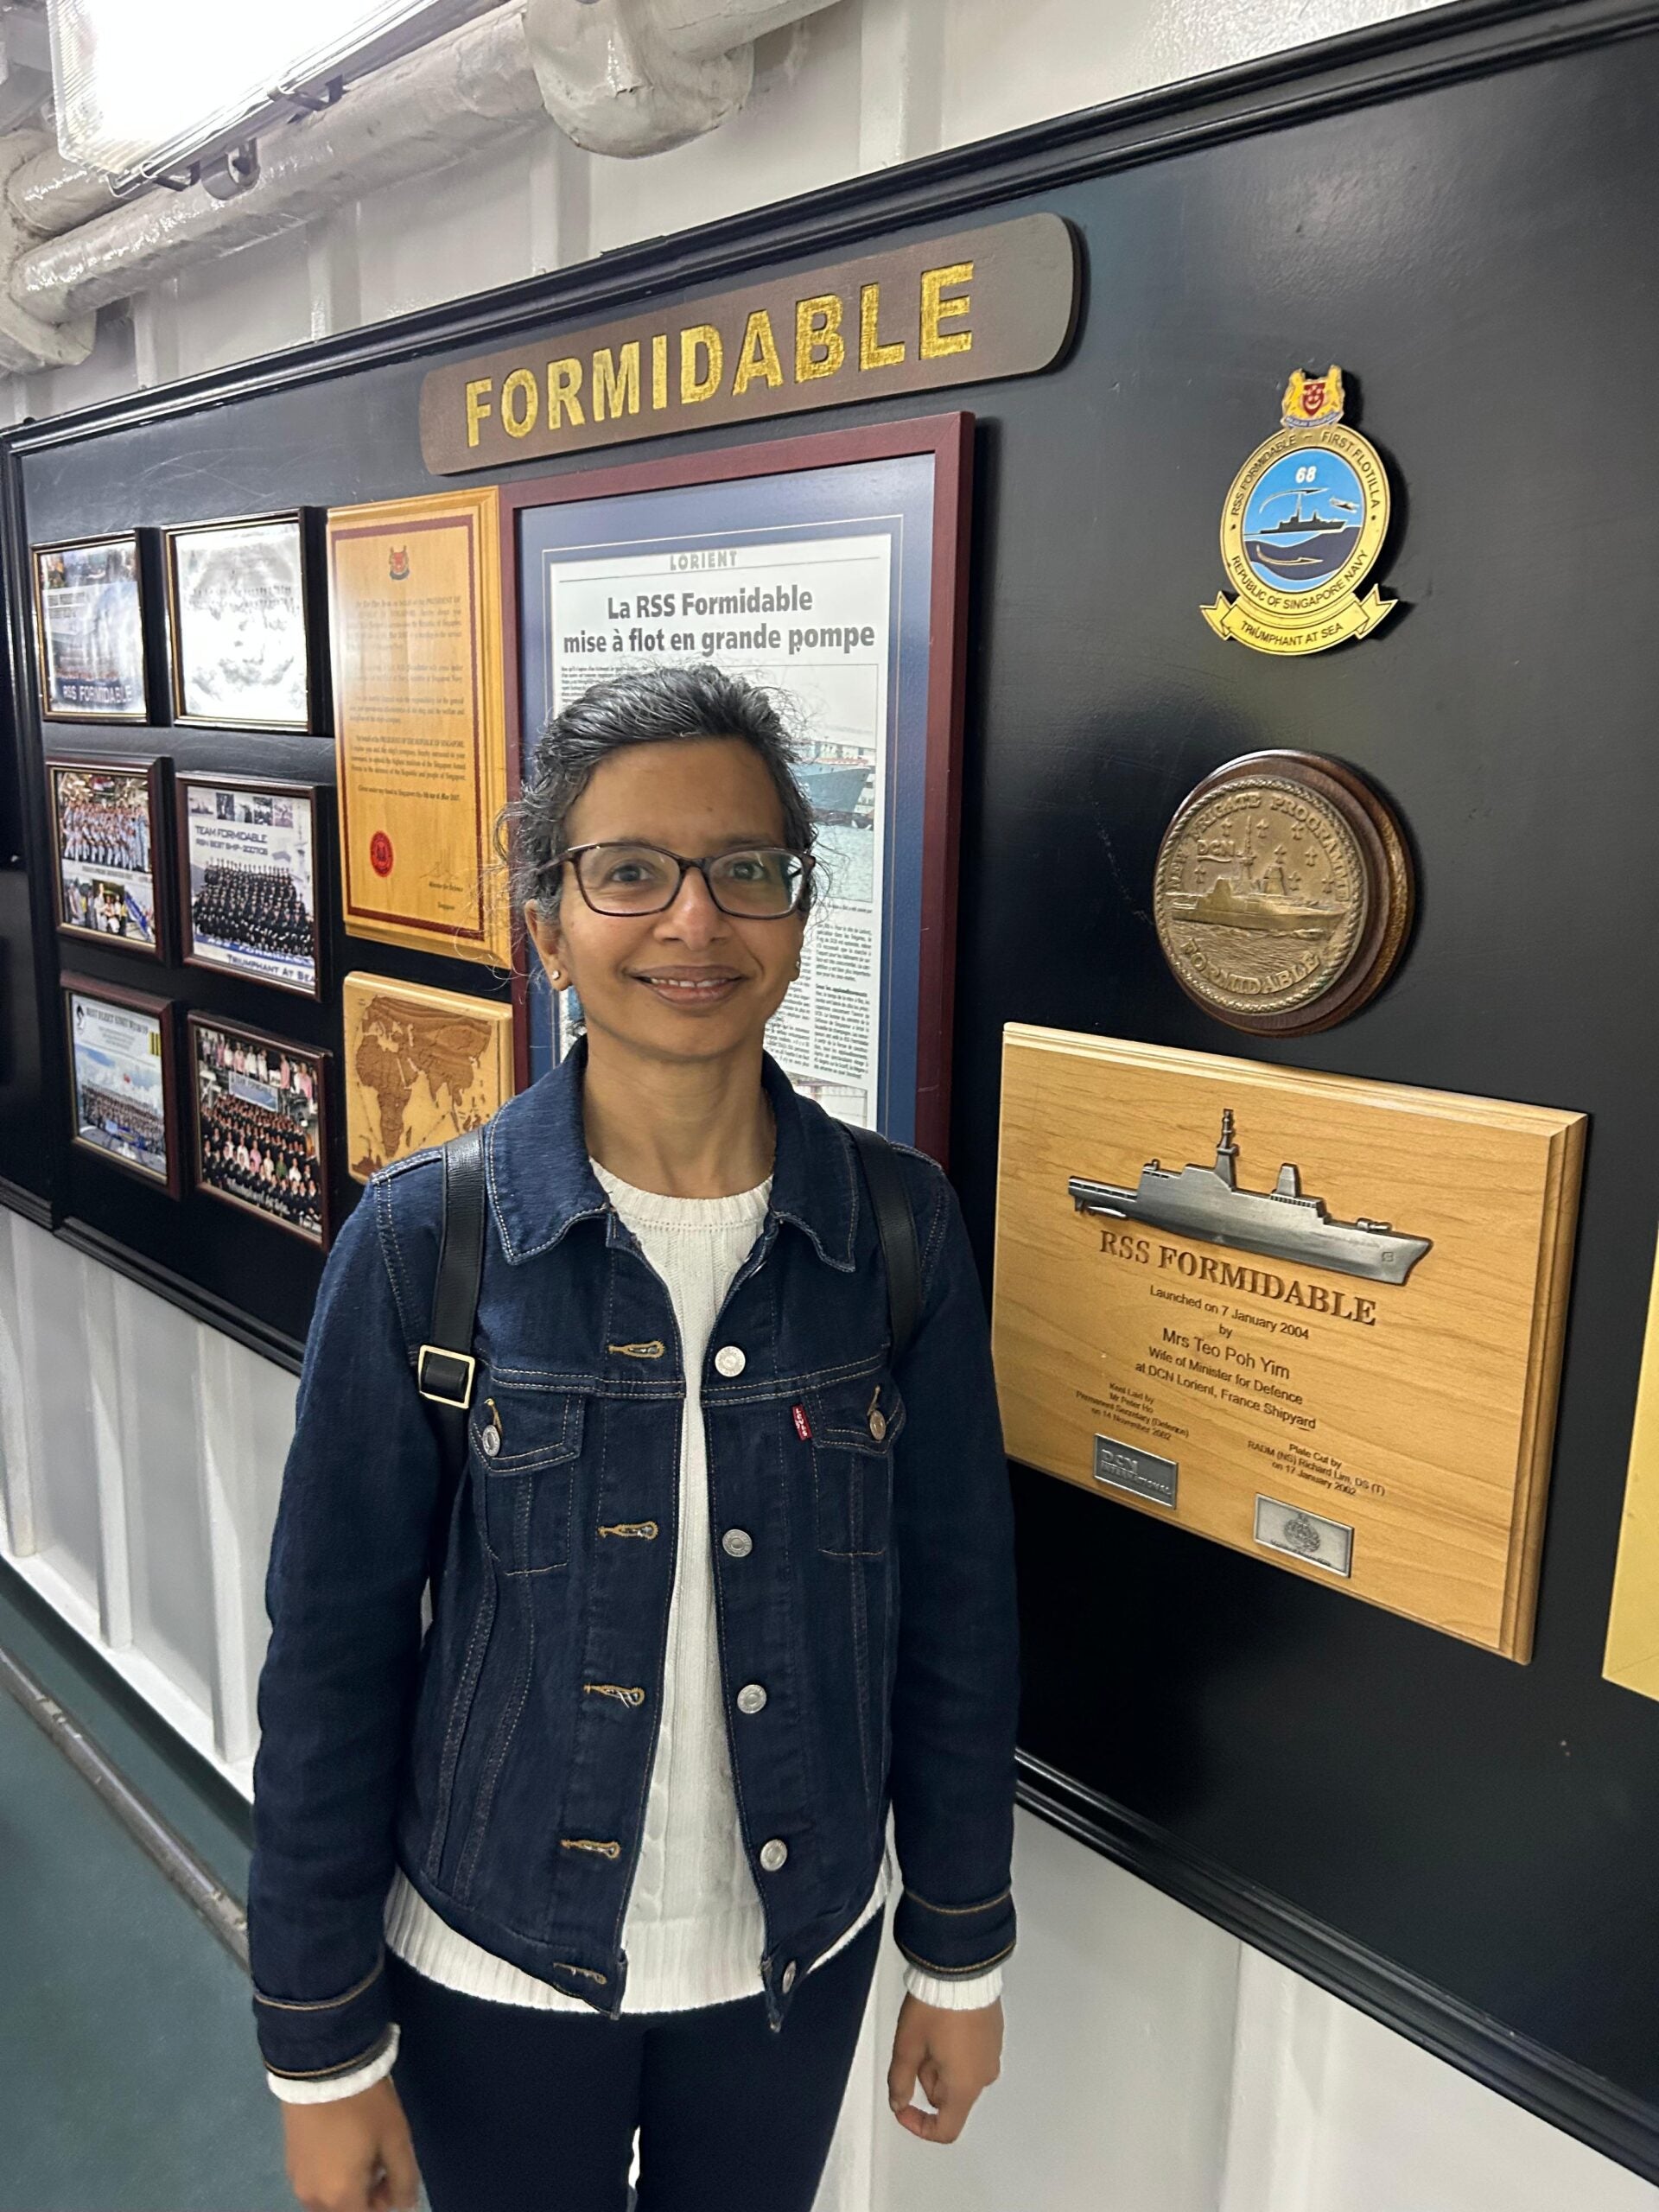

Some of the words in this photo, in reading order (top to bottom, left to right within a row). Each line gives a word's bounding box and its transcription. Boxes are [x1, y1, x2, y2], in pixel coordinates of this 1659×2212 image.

[465, 260, 975, 448] FORMIDABLE
[1230, 492, 1244, 516] RSS
[1240, 435, 1297, 490] FORMIDABLE
[1321, 431, 1355, 452] FIRST
[1351, 448, 1381, 509] FLOTILLA
[1296, 466, 1317, 483] 68
[670, 550, 738, 571] LORIENT
[1232, 556, 1267, 601] REPUBLIC
[1268, 595, 1281, 608] OF
[1283, 581, 1345, 609] SINGAPORE
[1346, 550, 1369, 582] NAVY
[607, 596, 631, 620] La
[637, 593, 676, 619] RSS
[682, 585, 813, 617] Formidable
[563, 629, 607, 654] mise
[612, 628, 624, 652] à
[629, 626, 664, 652] flot
[671, 630, 696, 651] en
[702, 622, 781, 658] grande
[788, 624, 875, 655] pompe
[1241, 620, 1303, 646] TRIUMPHANT
[1306, 632, 1318, 644] AT
[1321, 623, 1344, 639] SEA
[79, 685, 132, 703] FORMIDABLE
[194, 825, 217, 836] TEAM
[218, 829, 268, 844] FORMIDABLE
[1180, 938, 1321, 995] FORMIDABLE
[1099, 1230, 1150, 1264] RSS
[1158, 1245, 1376, 1326] FORMIDABLE
[1150, 1285, 1202, 1309] Launched
[1205, 1301, 1218, 1313] on
[1221, 1305, 1229, 1316] 7
[1231, 1309, 1277, 1333] January
[1281, 1322, 1309, 1340] 2004
[1219, 1323, 1233, 1338] by
[1162, 1327, 1190, 1349] Mrs
[1194, 1336, 1221, 1357] Teo
[1225, 1346, 1255, 1370] Poh
[1261, 1357, 1290, 1380] Yim
[1149, 1346, 1173, 1363] Wife
[1175, 1357, 1187, 1368] of
[1189, 1359, 1233, 1382] Minister
[1236, 1374, 1251, 1389] for
[1254, 1379, 1303, 1405] Defence
[1076, 1390, 1115, 1410] Permanent
[1116, 1404, 1150, 1425] Secretary
[1103, 1410, 1111, 1419] 14
[1109, 1393, 1120, 1402] Mr
[1121, 1396, 1141, 1409] Peter
[1142, 1404, 1154, 1414] Ho
[1135, 1363, 1146, 1373] at
[1148, 1365, 1174, 1382] DCN
[1177, 1374, 1217, 1398] Lorient,
[1221, 1389, 1261, 1411] France
[1263, 1402, 1316, 1431] Shipyard
[1145, 1395, 1154, 1405] by
[1248, 1440, 1275, 1456] RADM
[1277, 1450, 1296, 1465] (NS)
[1299, 1458, 1332, 1478] Richard
[1334, 1470, 1352, 1485] Lim,
[1355, 1478, 1369, 1490] DS
[1371, 1483, 1386, 1497] (T)
[1289, 1443, 1312, 1458] Plate
[1313, 1452, 1329, 1464] Cut
[1331, 1459, 1342, 1470] by
[1272, 1461, 1283, 1471] on
[1286, 1465, 1295, 1474] 17
[1298, 1470, 1332, 1489] January
[1334, 1482, 1357, 1497] 2002
